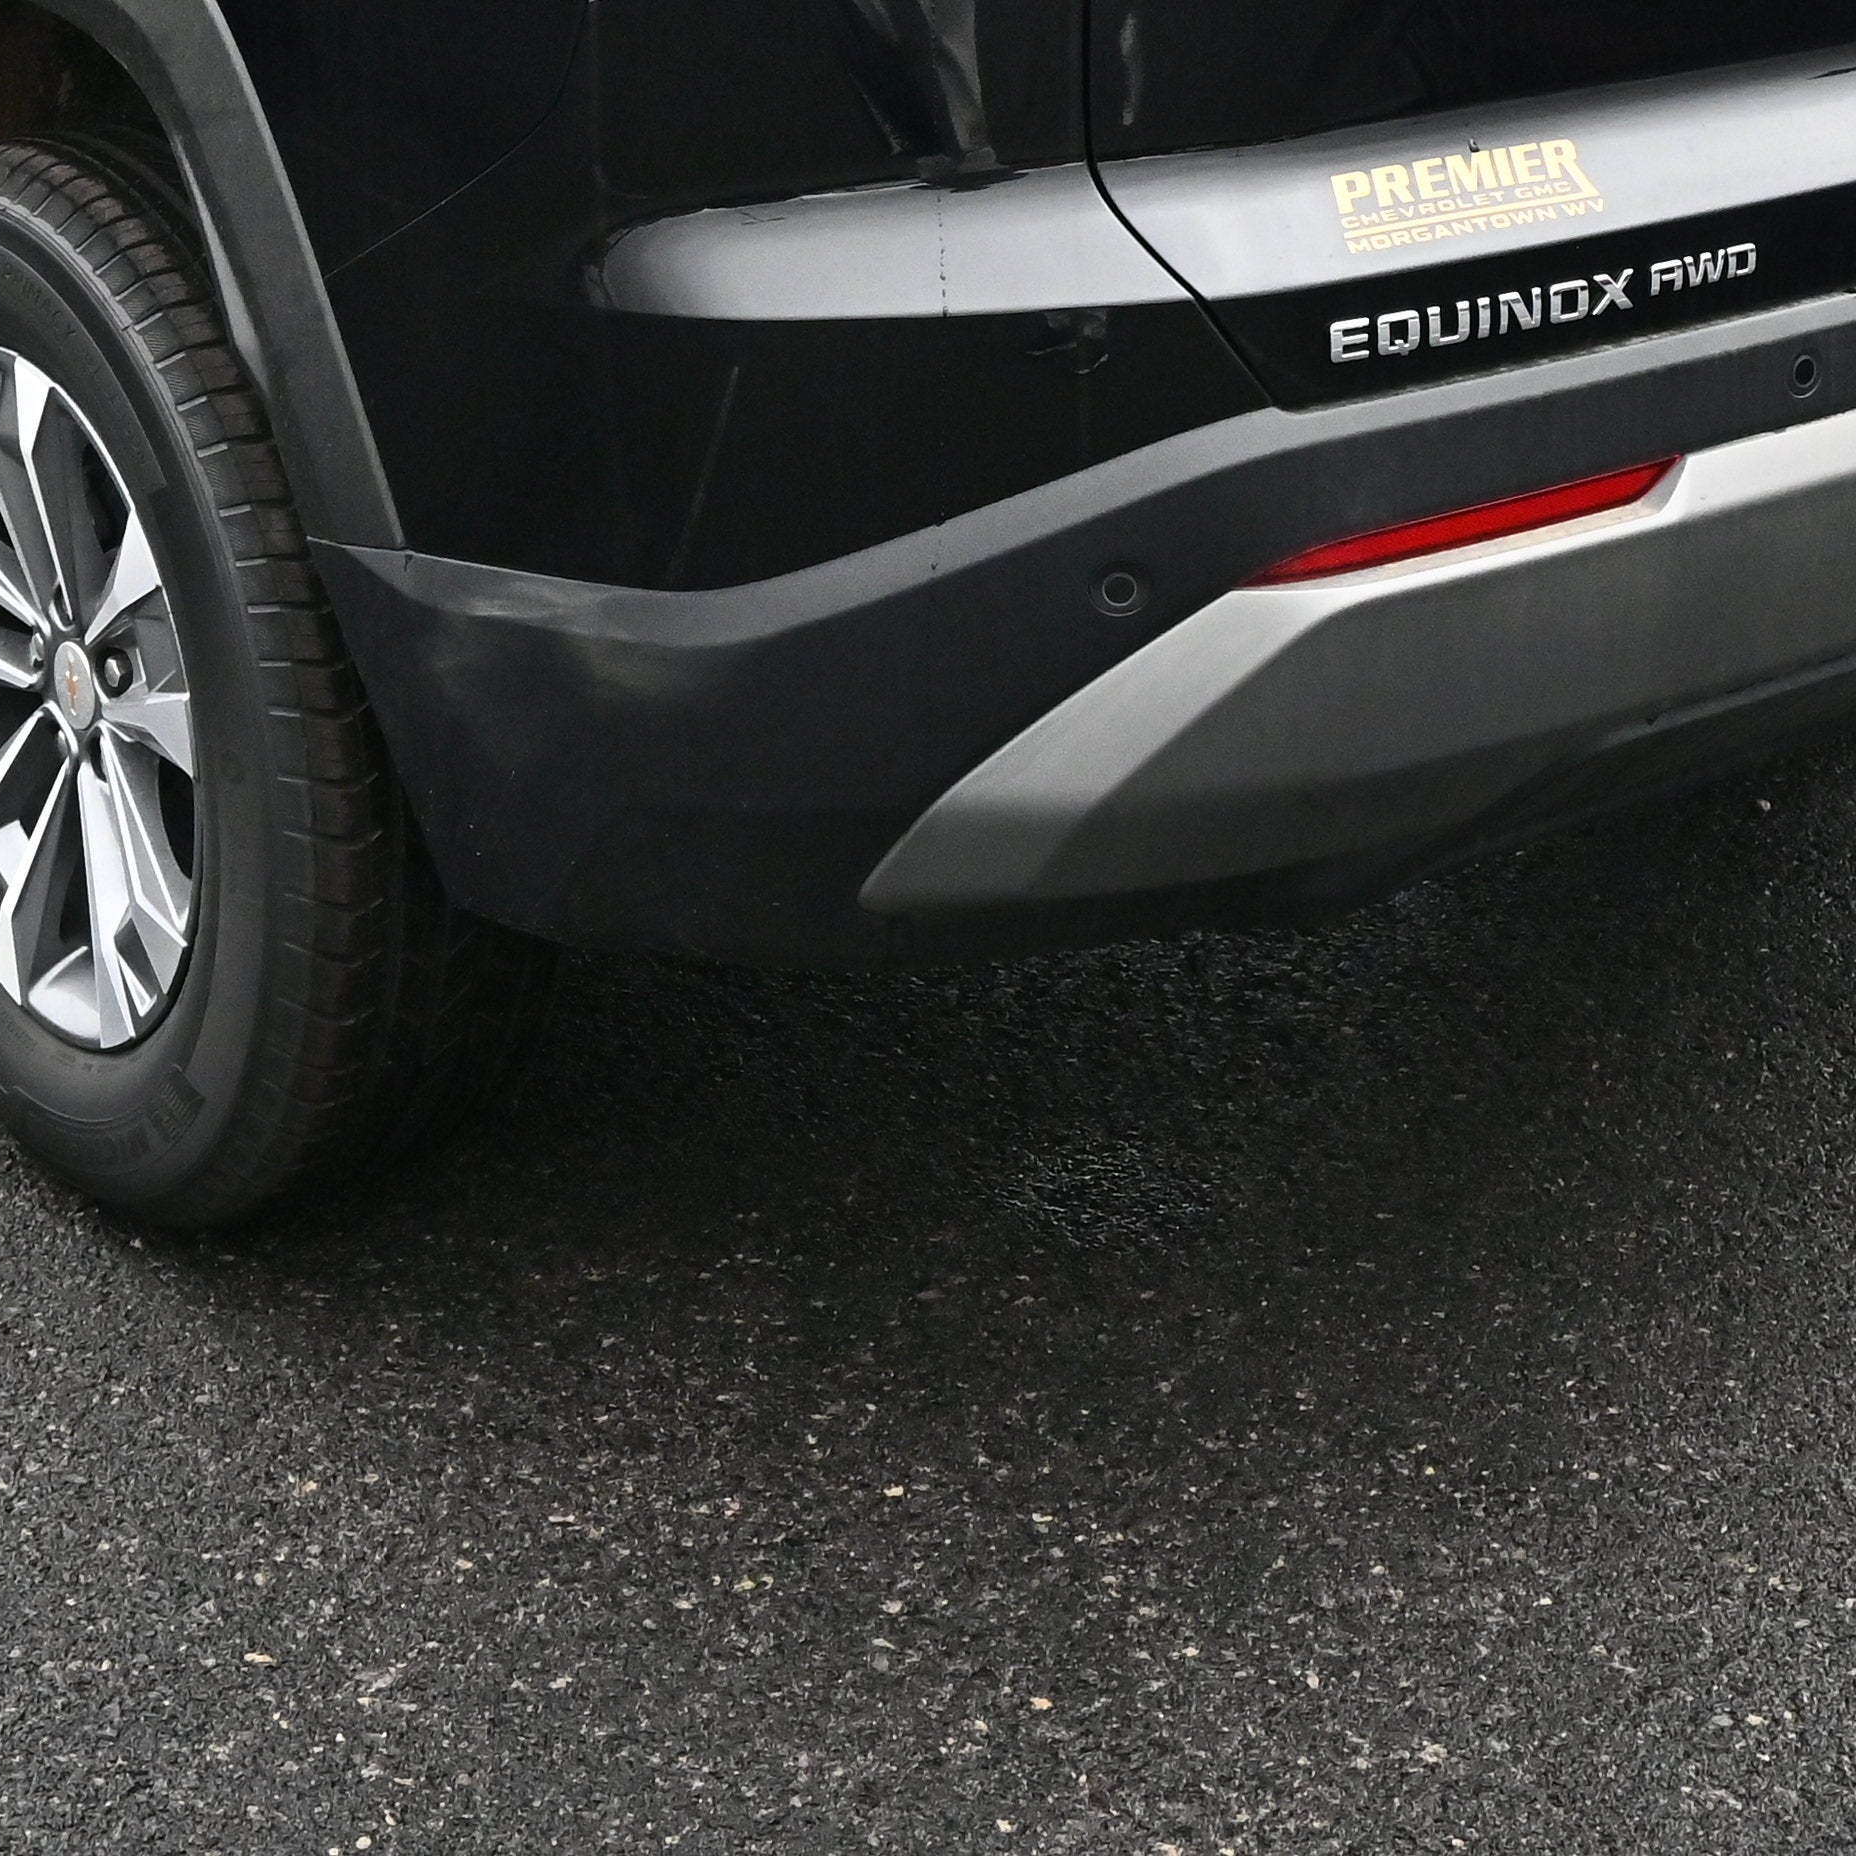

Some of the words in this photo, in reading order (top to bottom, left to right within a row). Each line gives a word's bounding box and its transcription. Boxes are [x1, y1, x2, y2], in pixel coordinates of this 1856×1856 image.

[1330, 138, 1600, 215] PREMIER
[1341, 191, 1507, 229] CHEVROLET
[1515, 180, 1572, 200] GMC
[1345, 207, 1558, 254] MORGANTOWN
[1560, 197, 1605, 218] WV
[1330, 267, 1635, 364] EQUINOX
[1649, 242, 1758, 297] AWD
